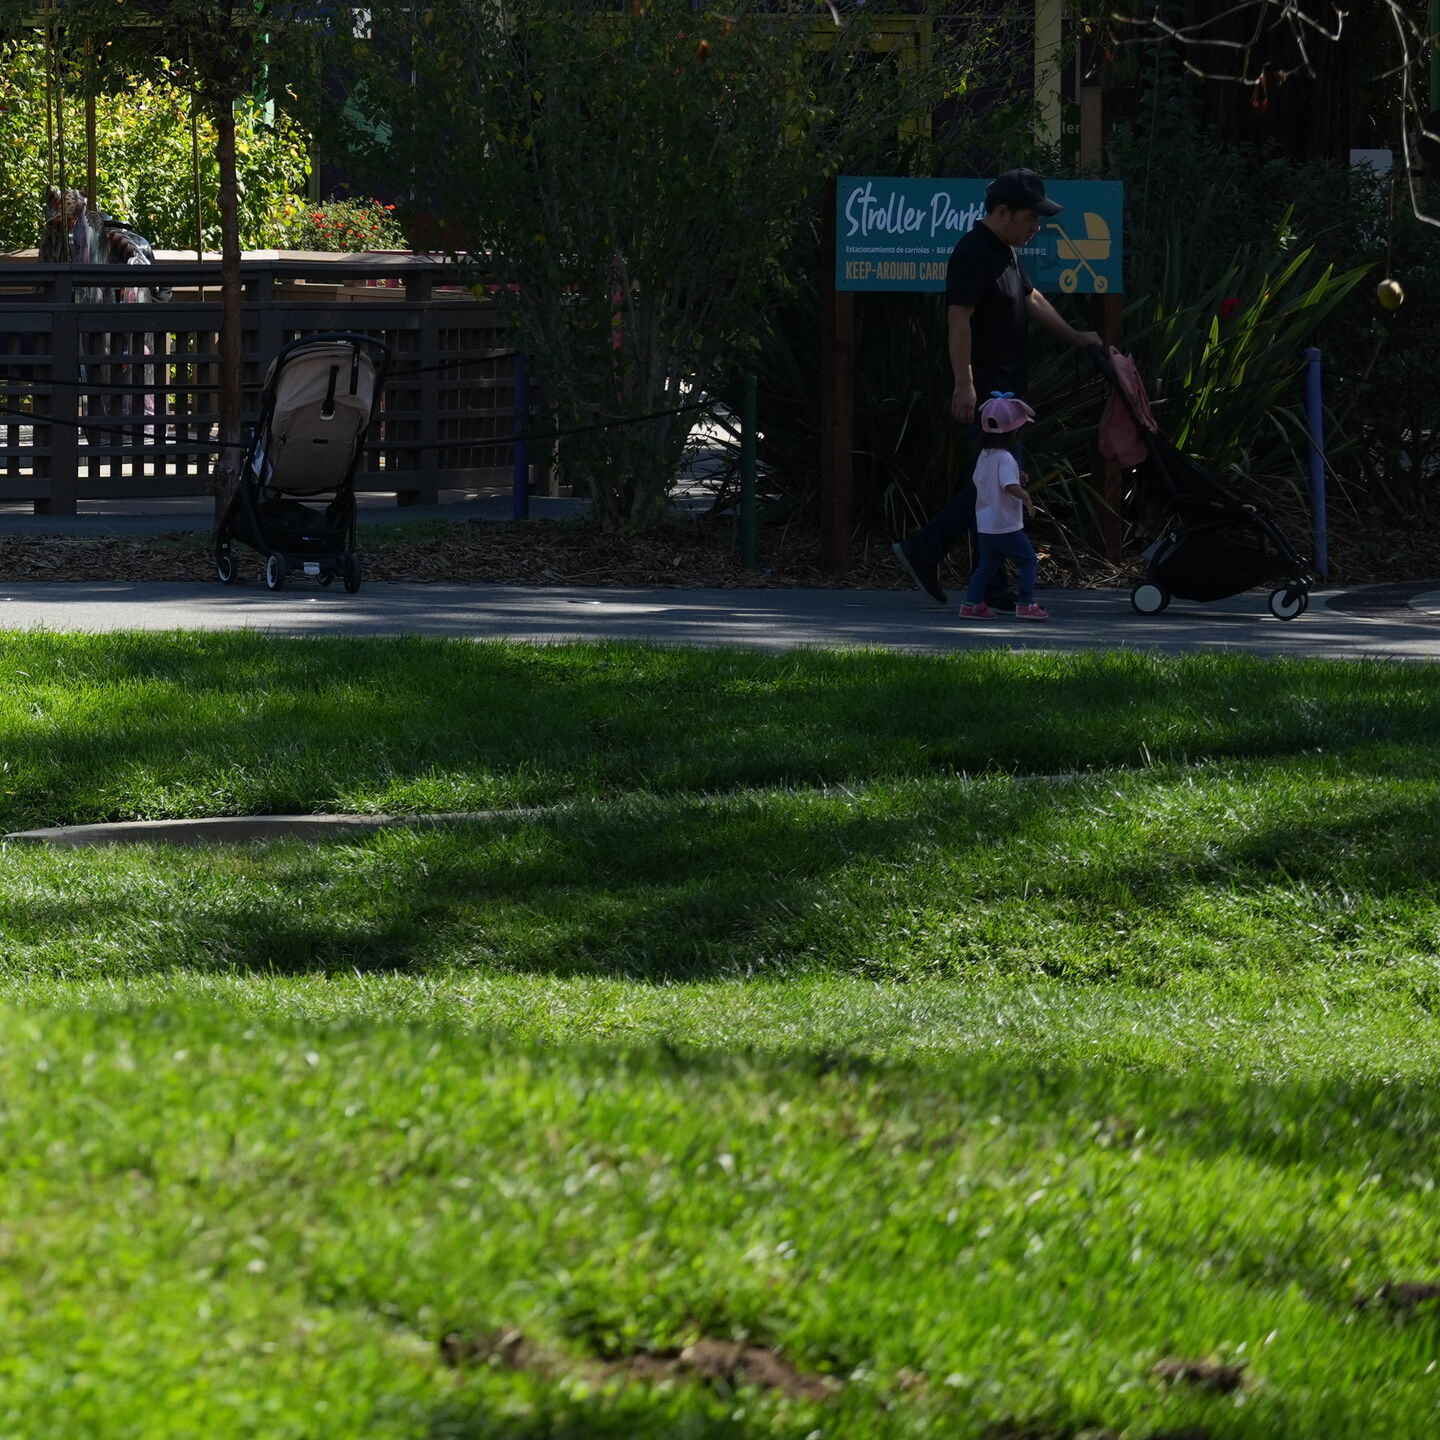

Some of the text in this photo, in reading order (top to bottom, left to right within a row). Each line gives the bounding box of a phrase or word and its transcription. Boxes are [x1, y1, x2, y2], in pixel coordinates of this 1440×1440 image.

[845, 181, 927, 238] Stroller
[845, 245, 895, 254] Estacionamiento
[896, 246, 904, 254] de
[904, 246, 930, 254] carriolas
[845, 261, 917, 280] KEEP-AROUND
